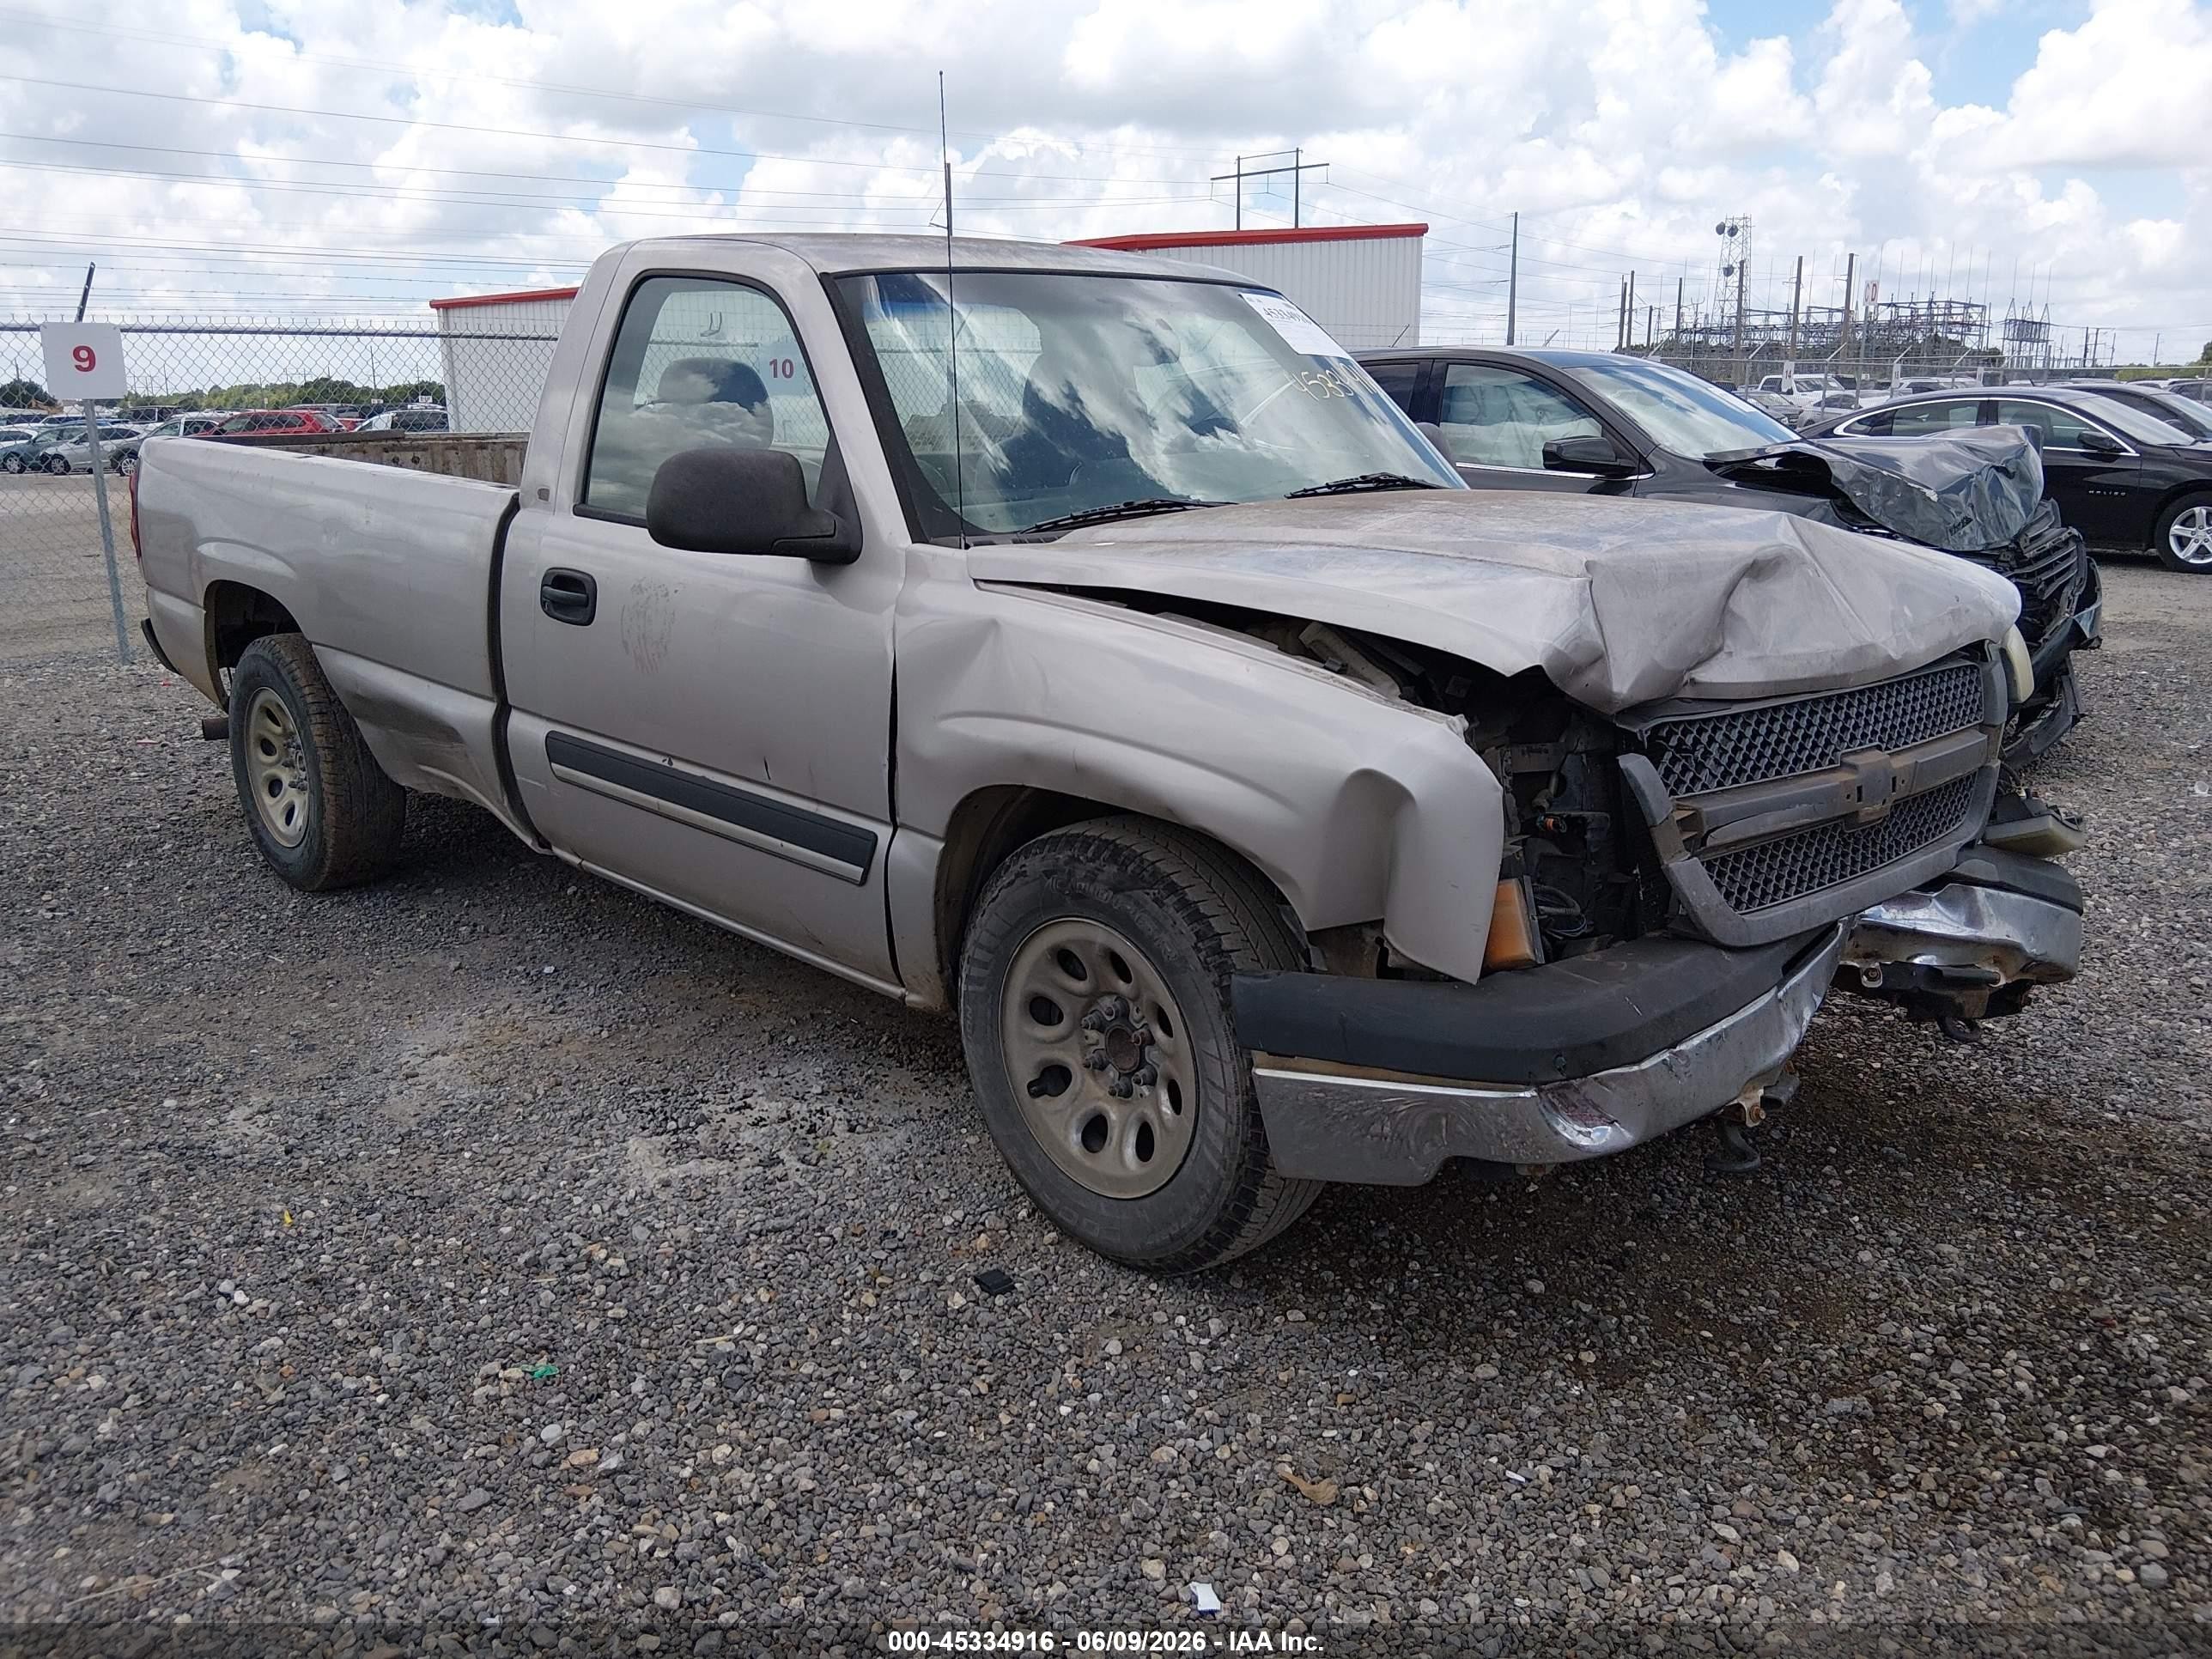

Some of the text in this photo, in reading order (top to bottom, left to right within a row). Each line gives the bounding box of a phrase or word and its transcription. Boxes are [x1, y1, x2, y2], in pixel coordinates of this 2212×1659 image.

[1870, 283, 1877, 302] D
[72, 344, 96, 373] 9
[769, 358, 795, 380] 10
